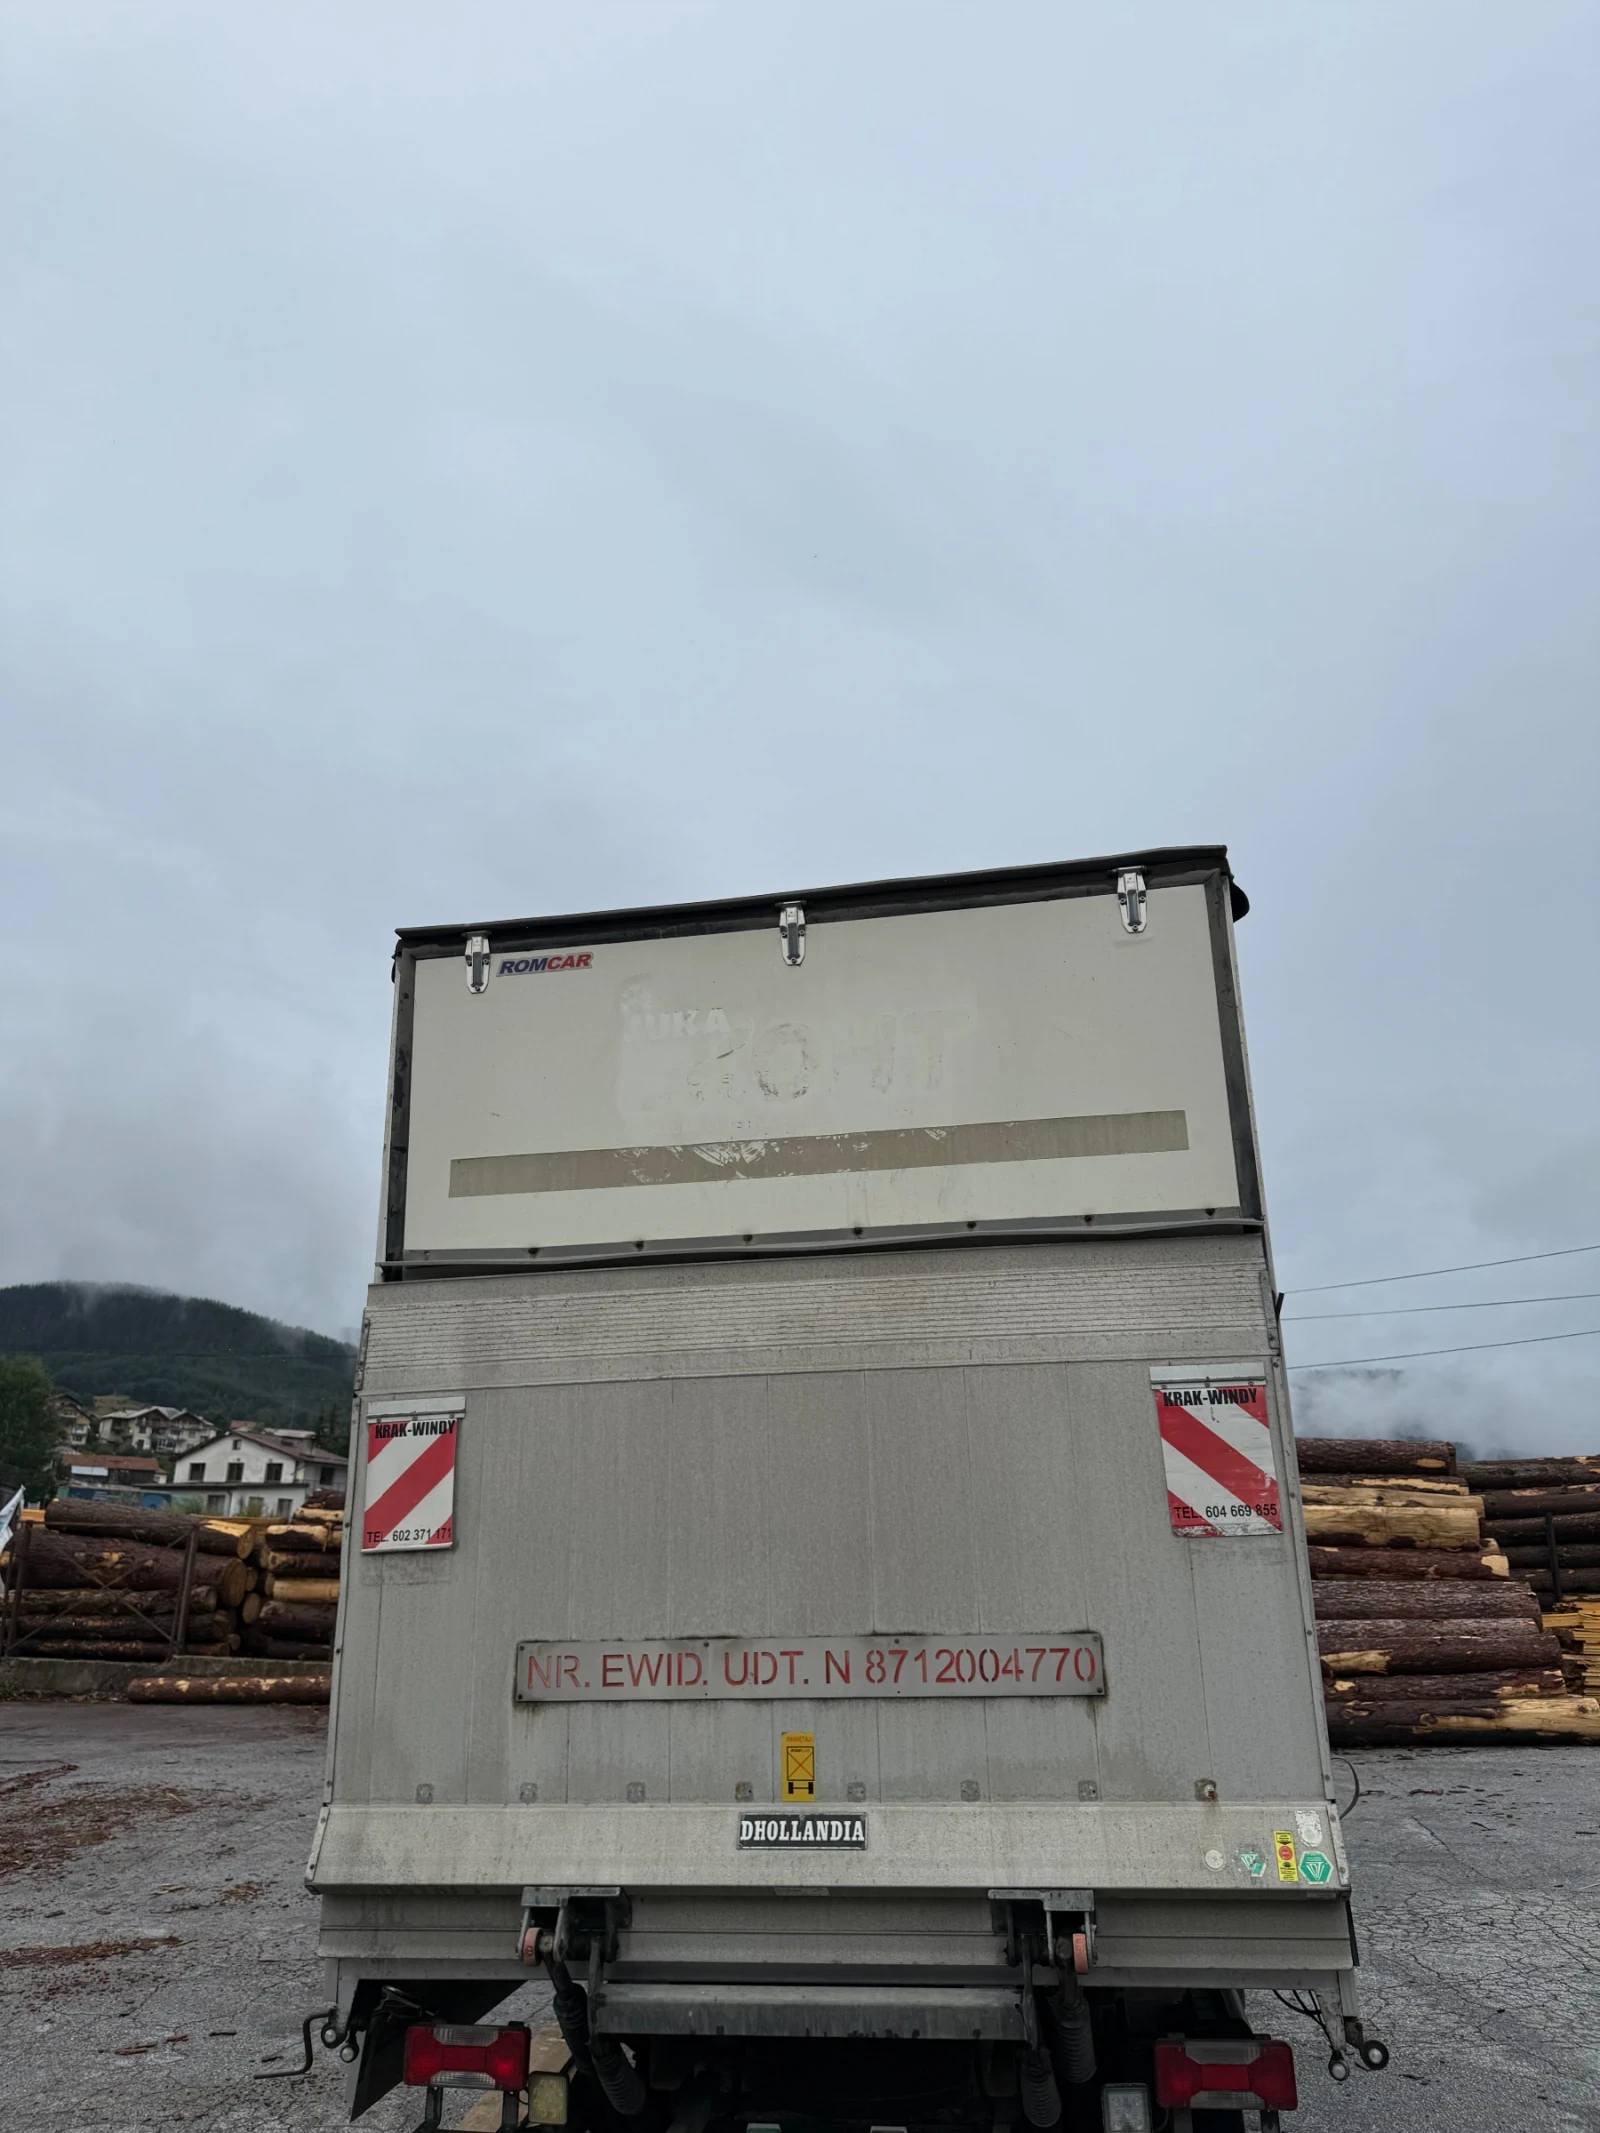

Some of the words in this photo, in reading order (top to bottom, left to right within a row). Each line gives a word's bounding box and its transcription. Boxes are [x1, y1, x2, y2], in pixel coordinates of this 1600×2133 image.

[499, 953, 592, 975] ROMCAR
[1163, 1387, 1258, 1408] KRAK-WINDY
[375, 1420, 456, 1439] KRAK-WINDY
[1174, 1506, 1202, 1519] TEL.
[1205, 1505, 1228, 1518] 604
[1230, 1504, 1252, 1517] 669
[1255, 1503, 1278, 1516] 855
[367, 1531, 389, 1543] TEL.
[392, 1530, 411, 1542] 602
[413, 1528, 431, 1541] 371
[527, 1655, 591, 1689] NR.
[602, 1652, 708, 1688] EWID.
[724, 1650, 809, 1686] UDT.
[825, 1650, 850, 1684] N
[865, 1647, 1097, 1685] 8712004770
[740, 1820, 865, 1841] DHOLLANDIA
